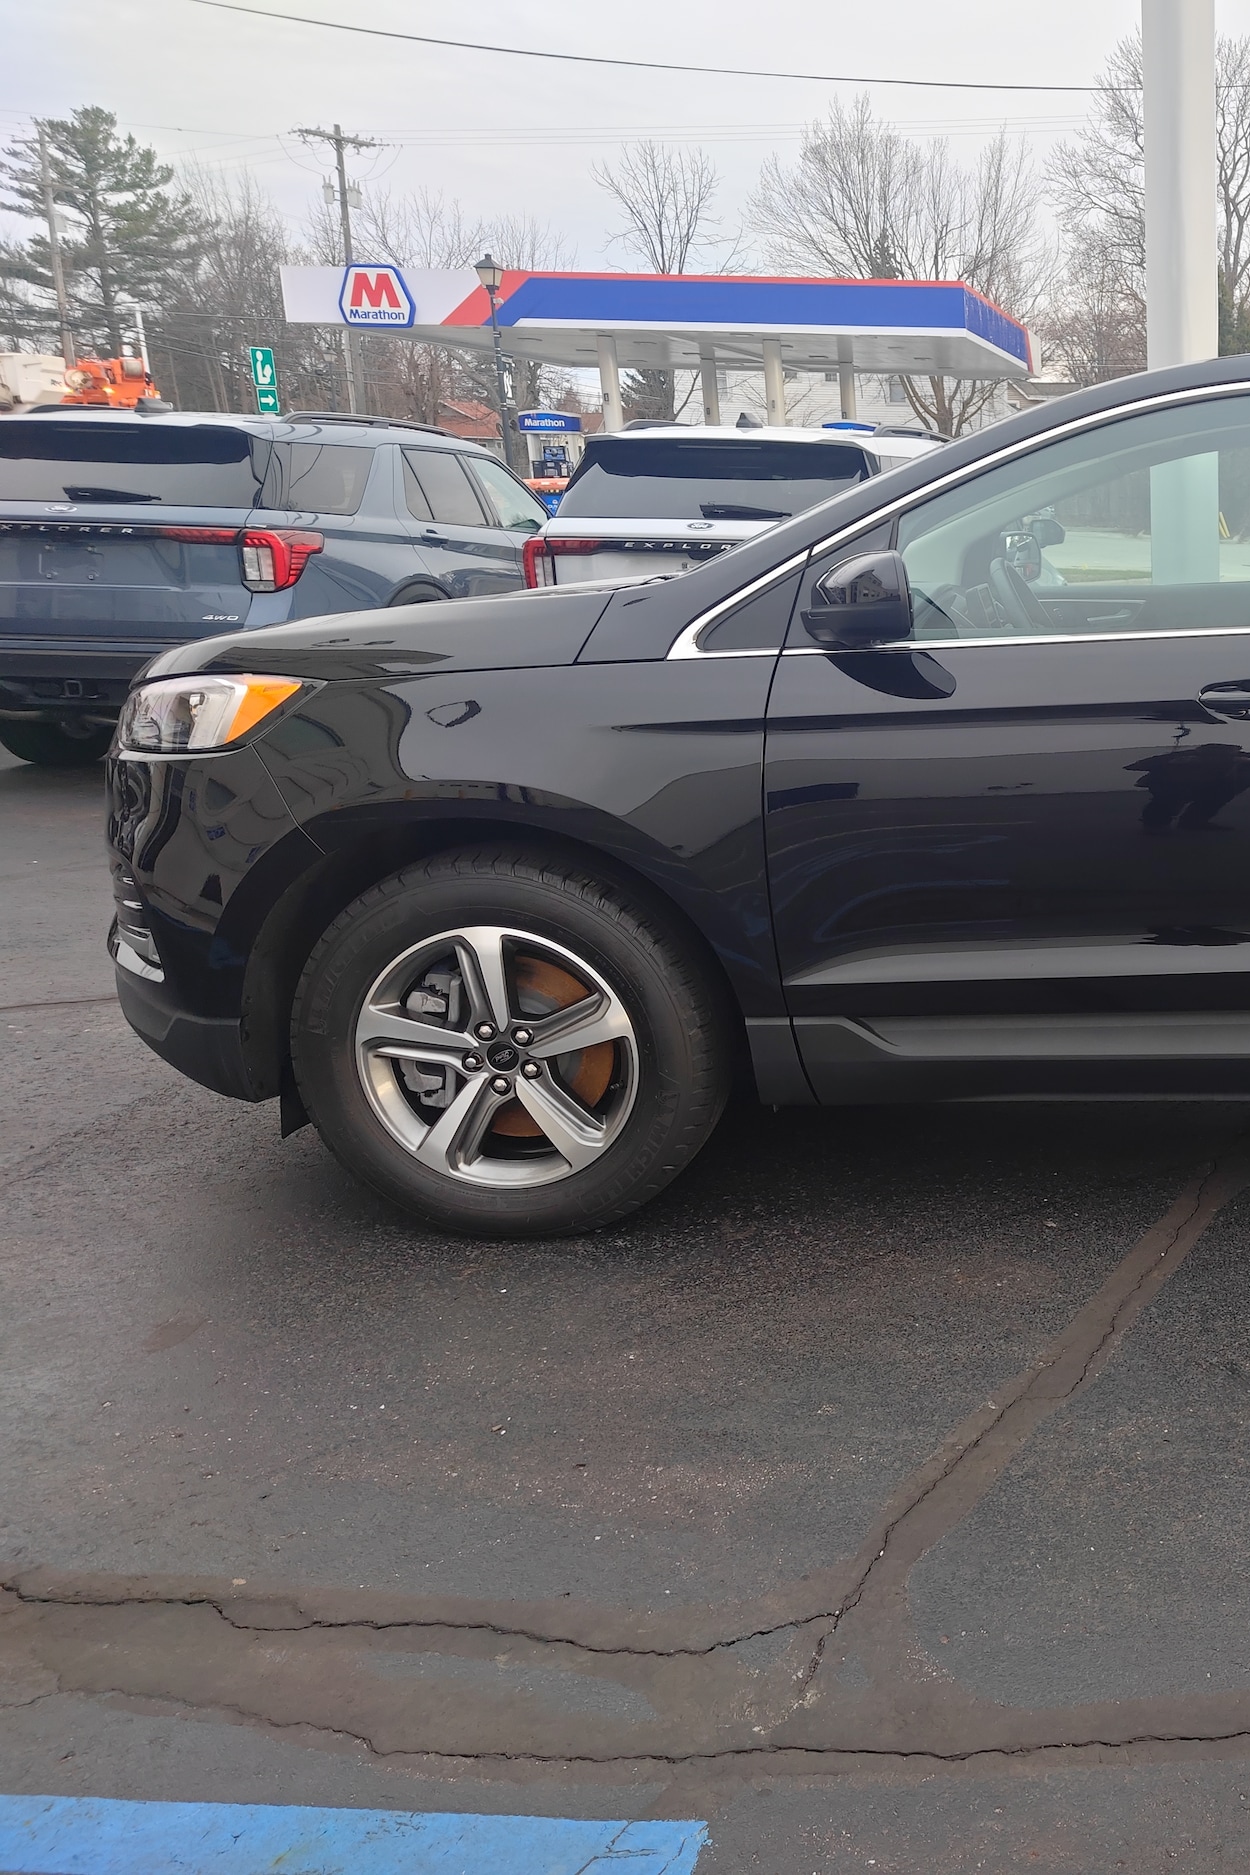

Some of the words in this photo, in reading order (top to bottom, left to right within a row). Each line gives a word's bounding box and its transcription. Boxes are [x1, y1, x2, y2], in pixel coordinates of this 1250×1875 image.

[350, 272, 402, 308] M
[349, 309, 406, 321] Marathon
[524, 418, 566, 428] Marathon
[0, 524, 134, 534] XPLORER
[624, 541, 732, 551] EXPLOR
